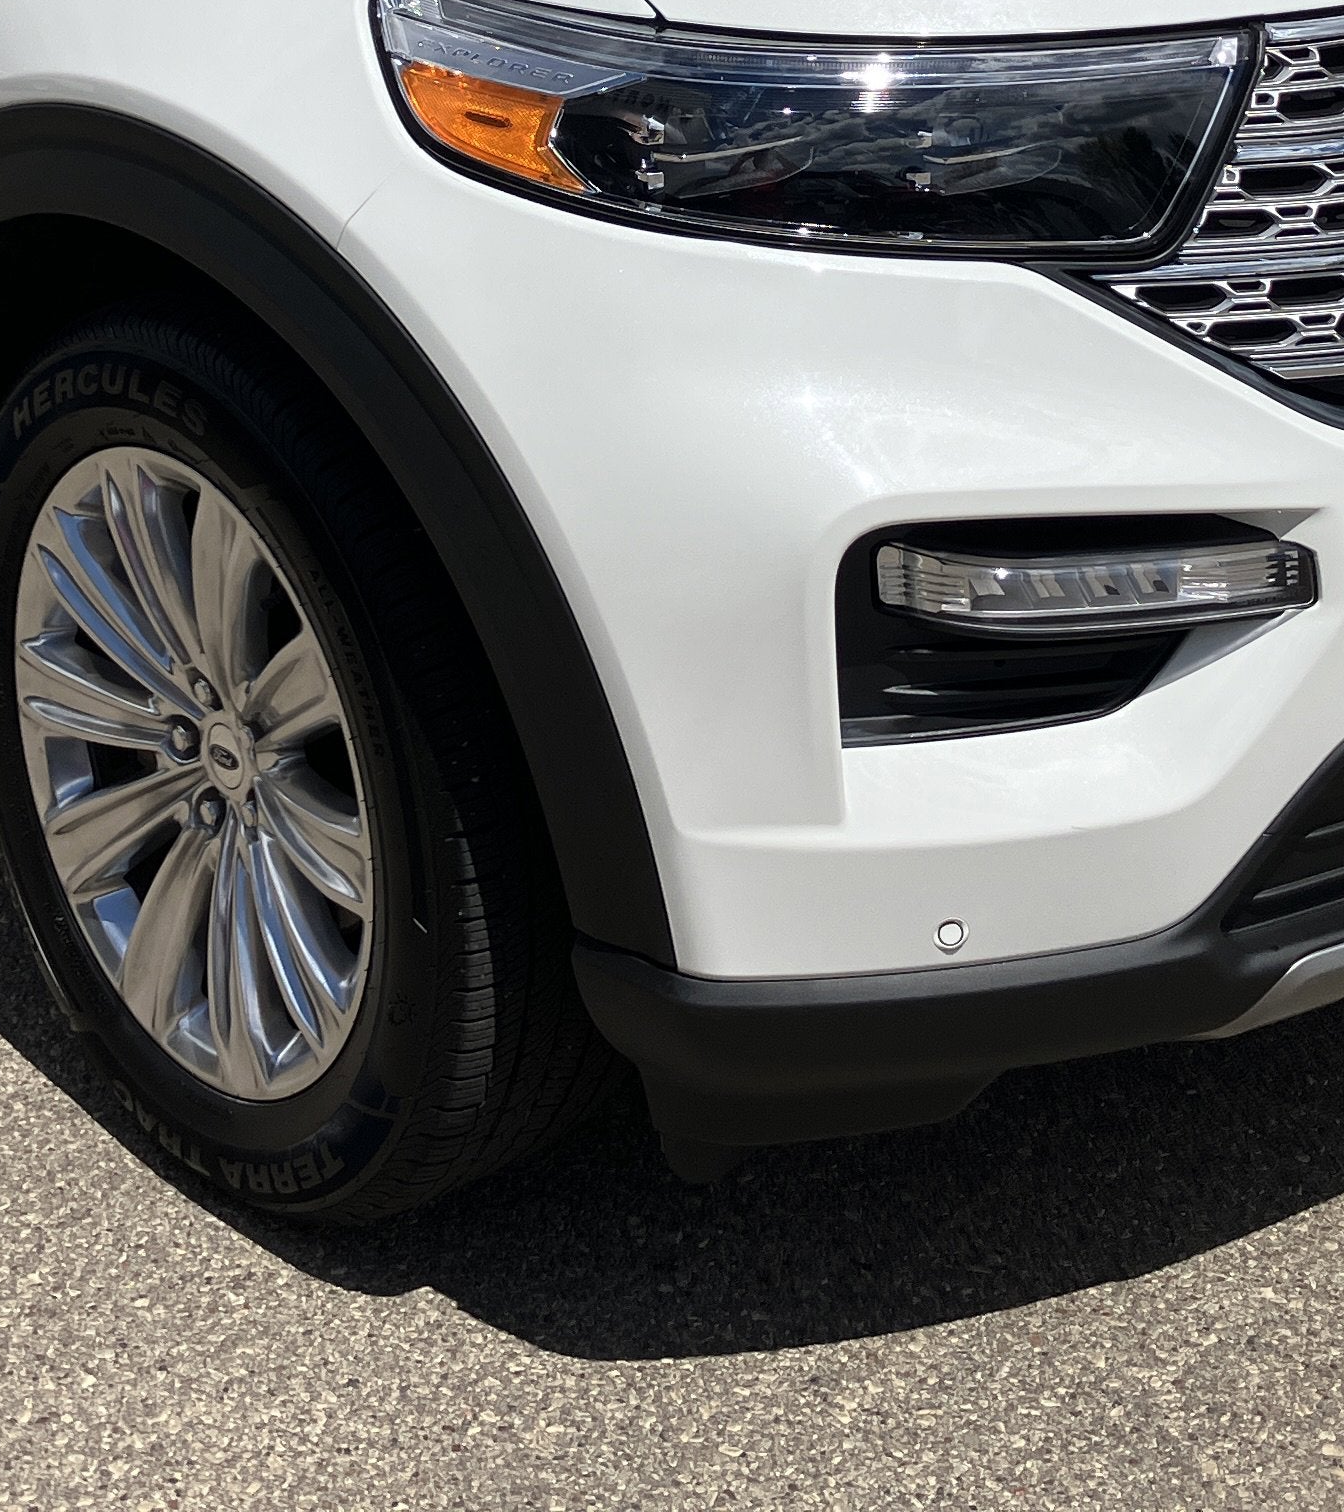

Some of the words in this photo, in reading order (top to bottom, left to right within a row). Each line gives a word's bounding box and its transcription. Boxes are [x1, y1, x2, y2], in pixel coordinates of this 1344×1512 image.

[418, 38, 574, 85] EXPLORER
[12, 363, 207, 440] HERCULES
[217, 1139, 345, 1194] TERRA
